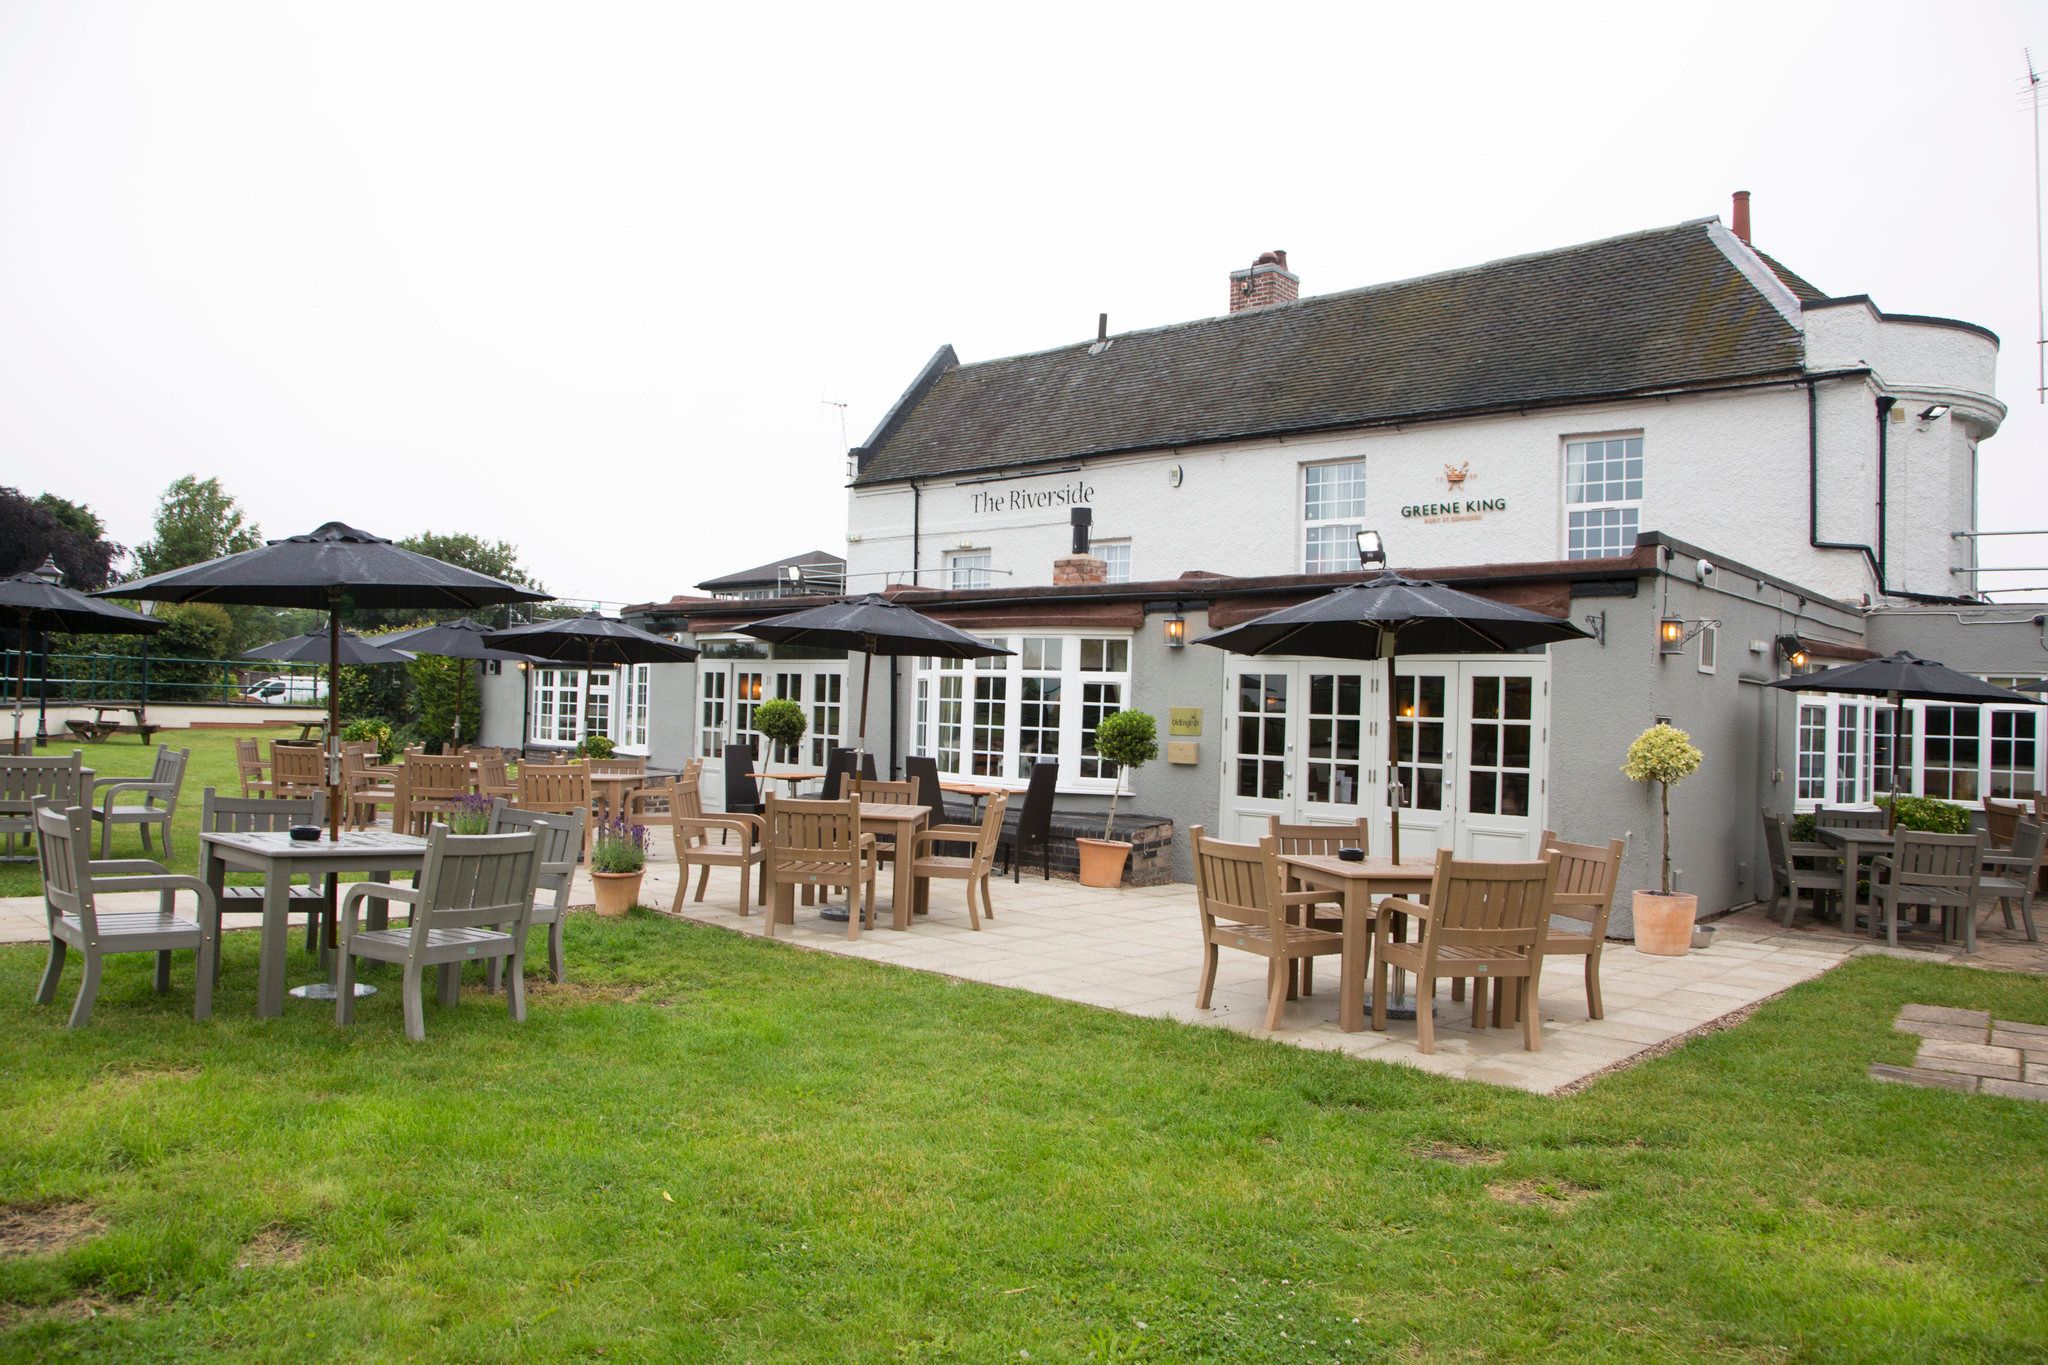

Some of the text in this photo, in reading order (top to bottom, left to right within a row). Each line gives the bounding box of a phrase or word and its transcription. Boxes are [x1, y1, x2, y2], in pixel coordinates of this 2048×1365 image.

[971, 481, 1094, 513] The Riverside
[1401, 498, 1506, 518] GREENE KING
